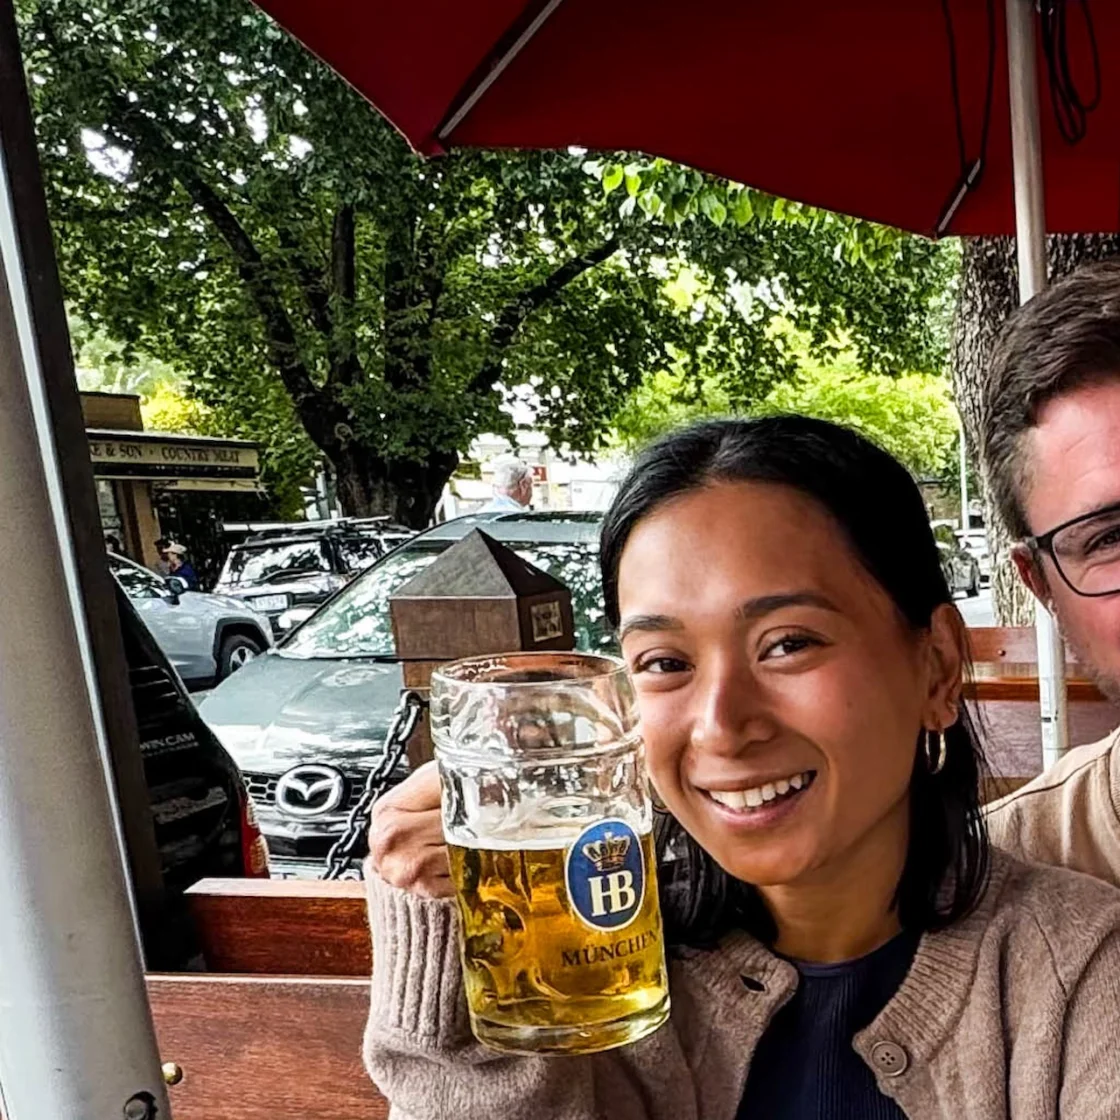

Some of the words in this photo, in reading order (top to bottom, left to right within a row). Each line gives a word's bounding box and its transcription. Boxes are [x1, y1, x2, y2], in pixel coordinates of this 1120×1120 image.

[119, 442, 143, 459] SON
[161, 446, 210, 462] COUNTRY
[212, 449, 241, 463] MEAT
[588, 869, 636, 918] HB
[562, 930, 658, 967] MÜNCHEN
